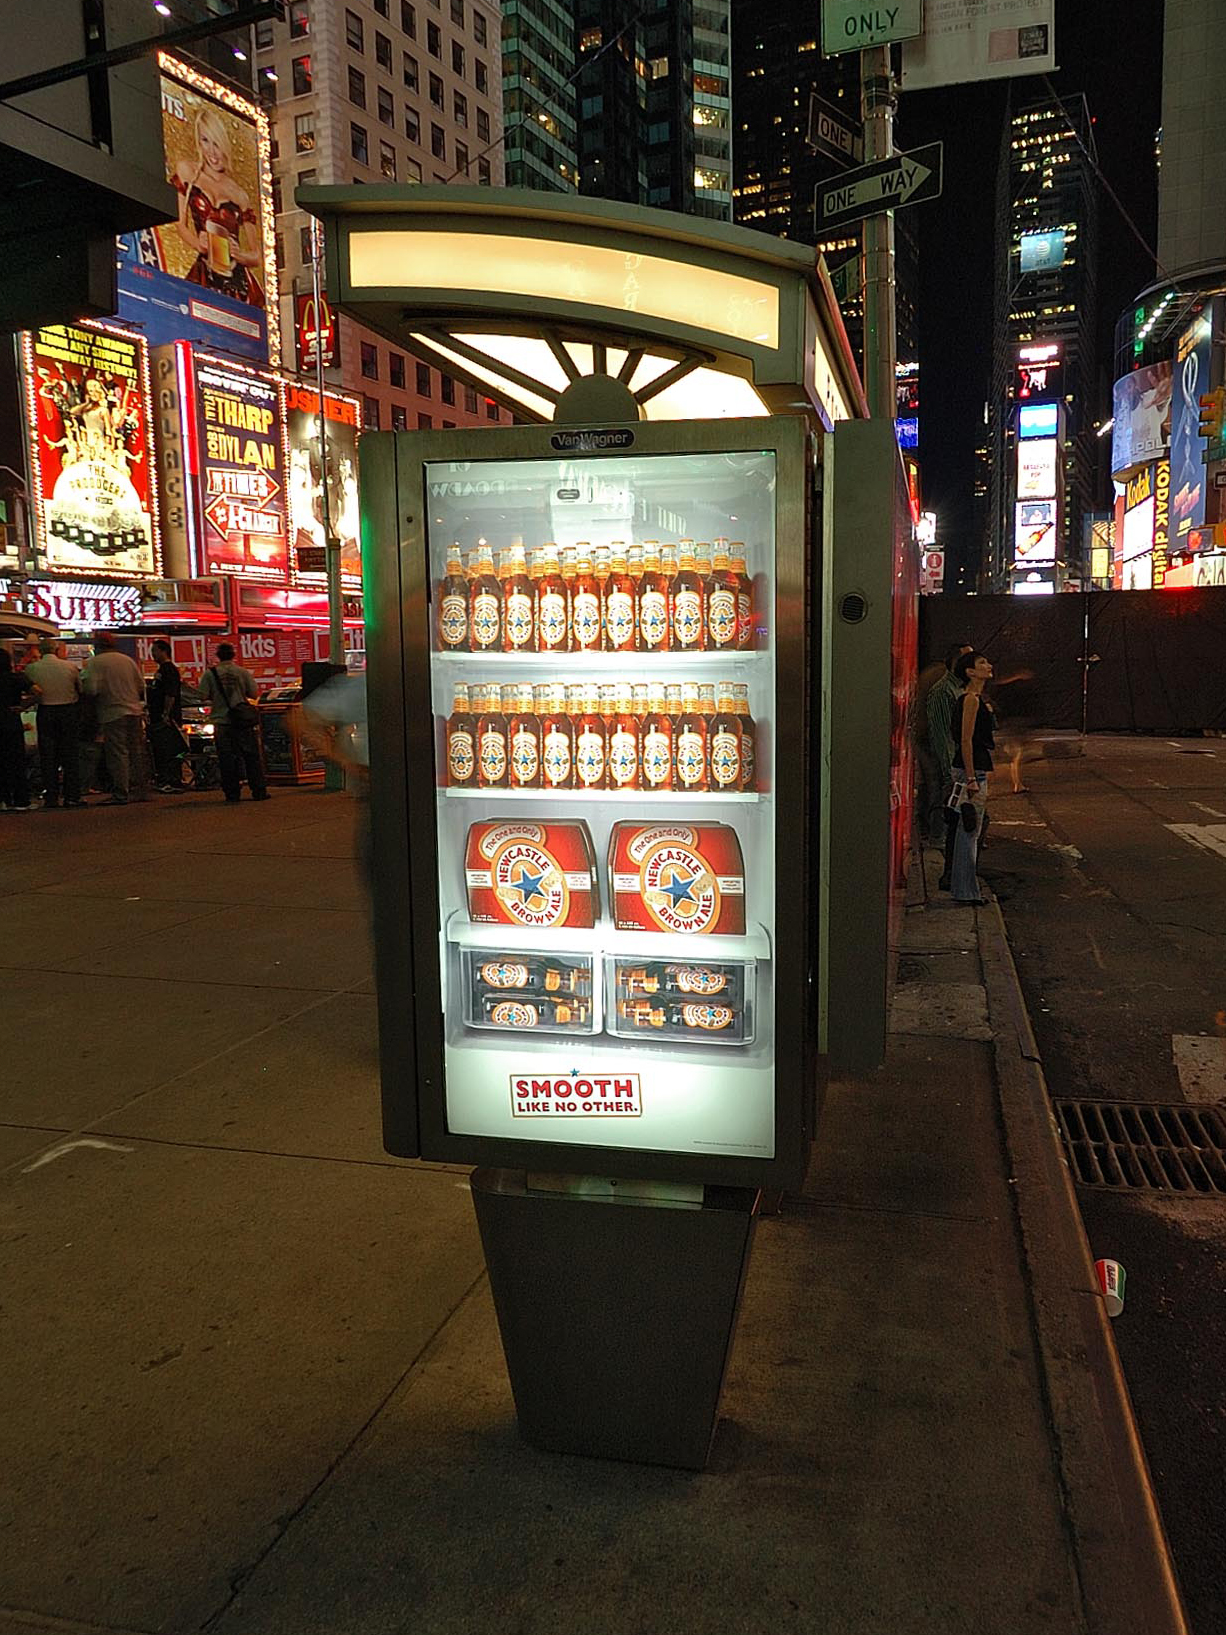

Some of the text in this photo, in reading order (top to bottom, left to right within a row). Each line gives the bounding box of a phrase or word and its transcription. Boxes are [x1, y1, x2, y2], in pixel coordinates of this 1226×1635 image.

[844, 7, 900, 36] ONLY
[820, 119, 848, 149] ONE
[826, 166, 919, 213] ONE WAY
[214, 397, 274, 434] THARP
[218, 434, 276, 470] DYLAN
[1154, 460, 1170, 590] KODAK digital
[34, 585, 137, 623] SUITES
[241, 634, 276, 658] tkts
[486, 838, 497, 851] The
[634, 840, 647, 853] The
[673, 828, 691, 840] Only
[499, 847, 550, 883] NEWCASTLE
[648, 850, 702, 887] NEWCASTLE
[511, 902, 555, 924] BROWN
[551, 890, 561, 912] ALE
[659, 894, 712, 931] BROWN ALE
[515, 1079, 633, 1099] SMOOTH
[517, 1101, 639, 1113] LIKE NO OTHER.
